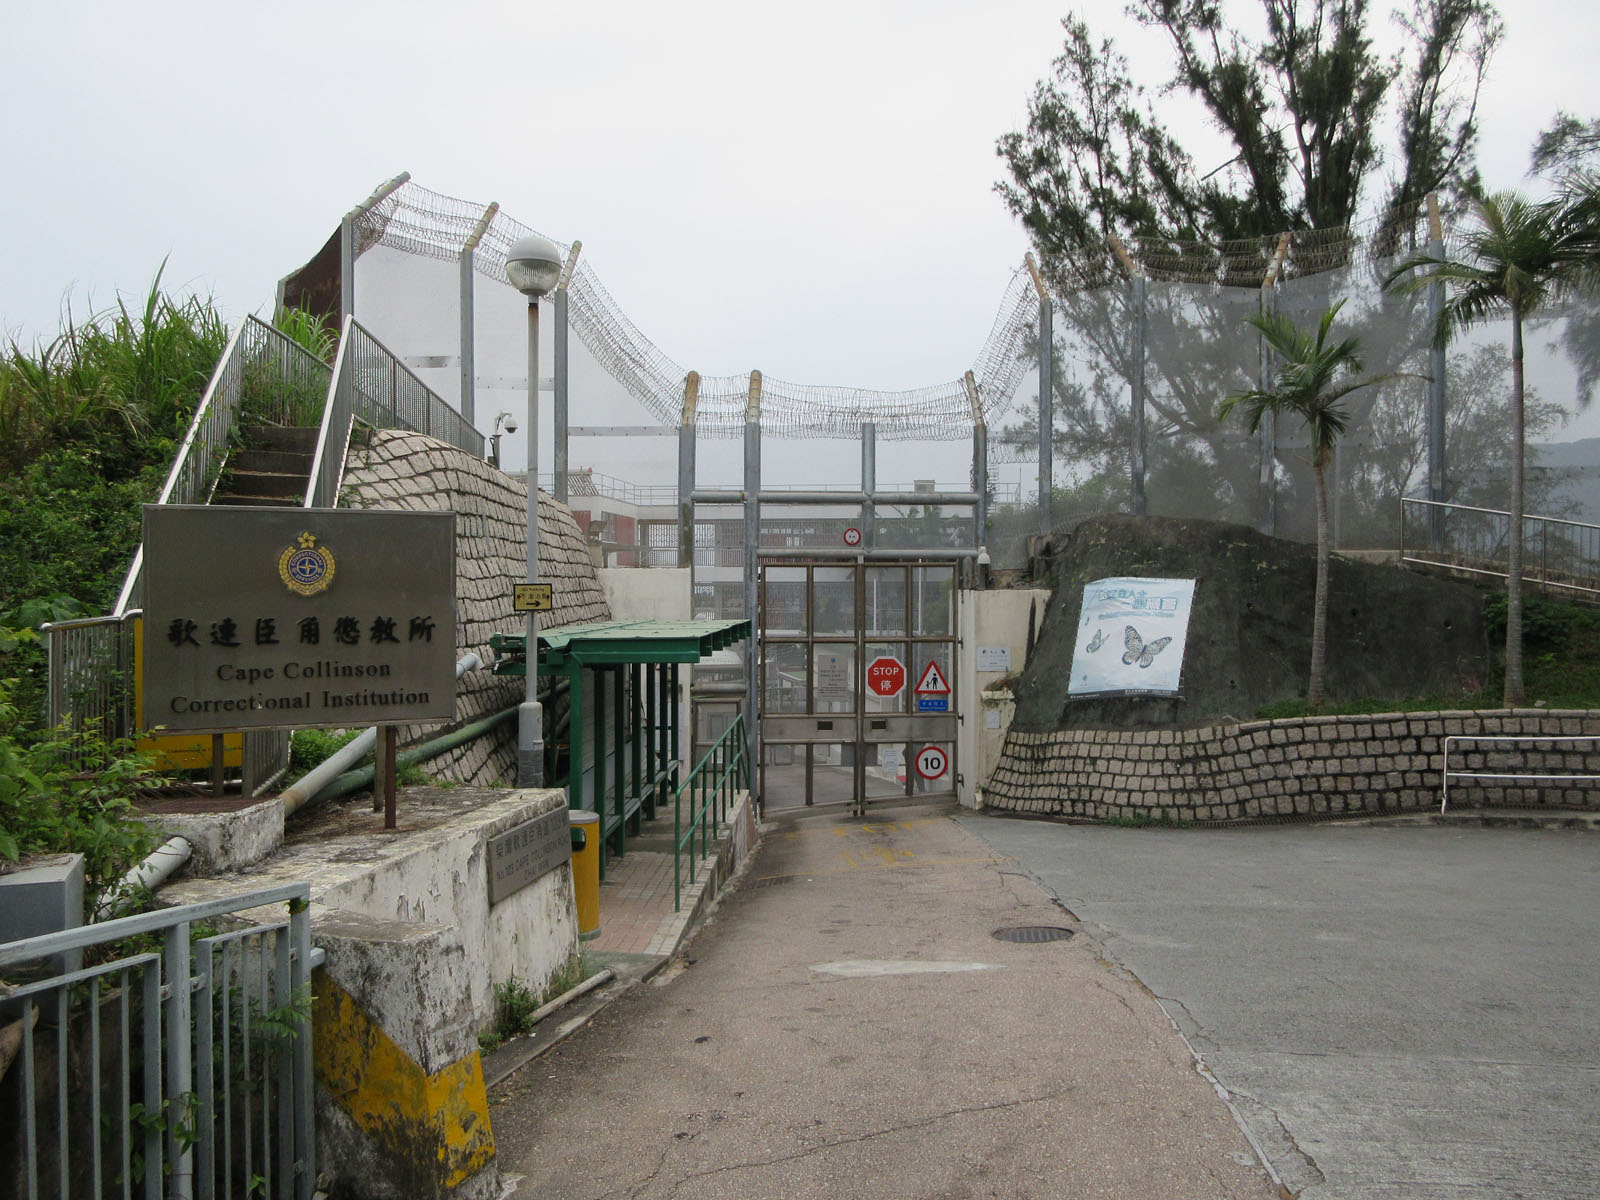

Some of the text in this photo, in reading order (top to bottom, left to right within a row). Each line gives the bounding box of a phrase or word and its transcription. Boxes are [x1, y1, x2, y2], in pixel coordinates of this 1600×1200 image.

[291, 551, 323, 566] CORRECTIONAL
[217, 660, 391, 685] Cape Collinson
[873, 667, 899, 676] STOP
[880, 680, 892, 691] 停
[170, 688, 431, 714] Correctional Institution
[924, 757, 941, 770] 10
